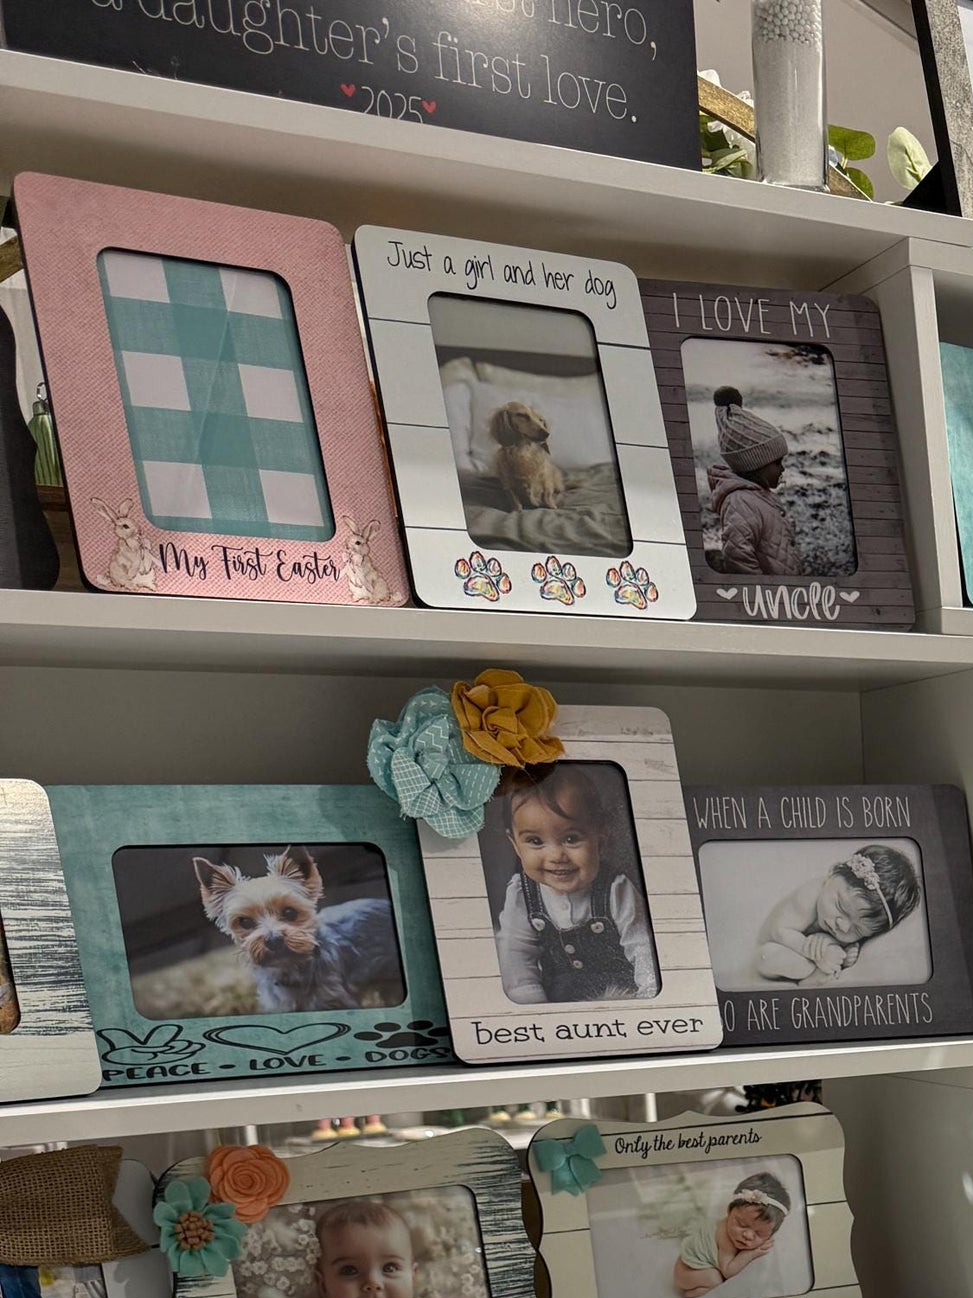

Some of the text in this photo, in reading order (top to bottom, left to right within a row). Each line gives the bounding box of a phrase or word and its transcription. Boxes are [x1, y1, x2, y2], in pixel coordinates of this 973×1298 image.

[432, 31, 531, 99] first
[540, 54, 637, 123] love.
[387, 241, 617, 310] Just a girl and her dog
[672, 292, 830, 338] I LOVE MY
[159, 542, 341, 584] My First Easter
[742, 581, 841, 621] uncle
[693, 796, 911, 829] WHEN A CHILD IS BORN
[471, 1017, 704, 1045] best aunt ever
[747, 998, 780, 1031] ARE
[791, 992, 933, 1030] GRANDPARENTS
[102, 1046, 452, 1081] PEACE LOVE DOGS
[615, 1128, 762, 1160] Only the best parents
